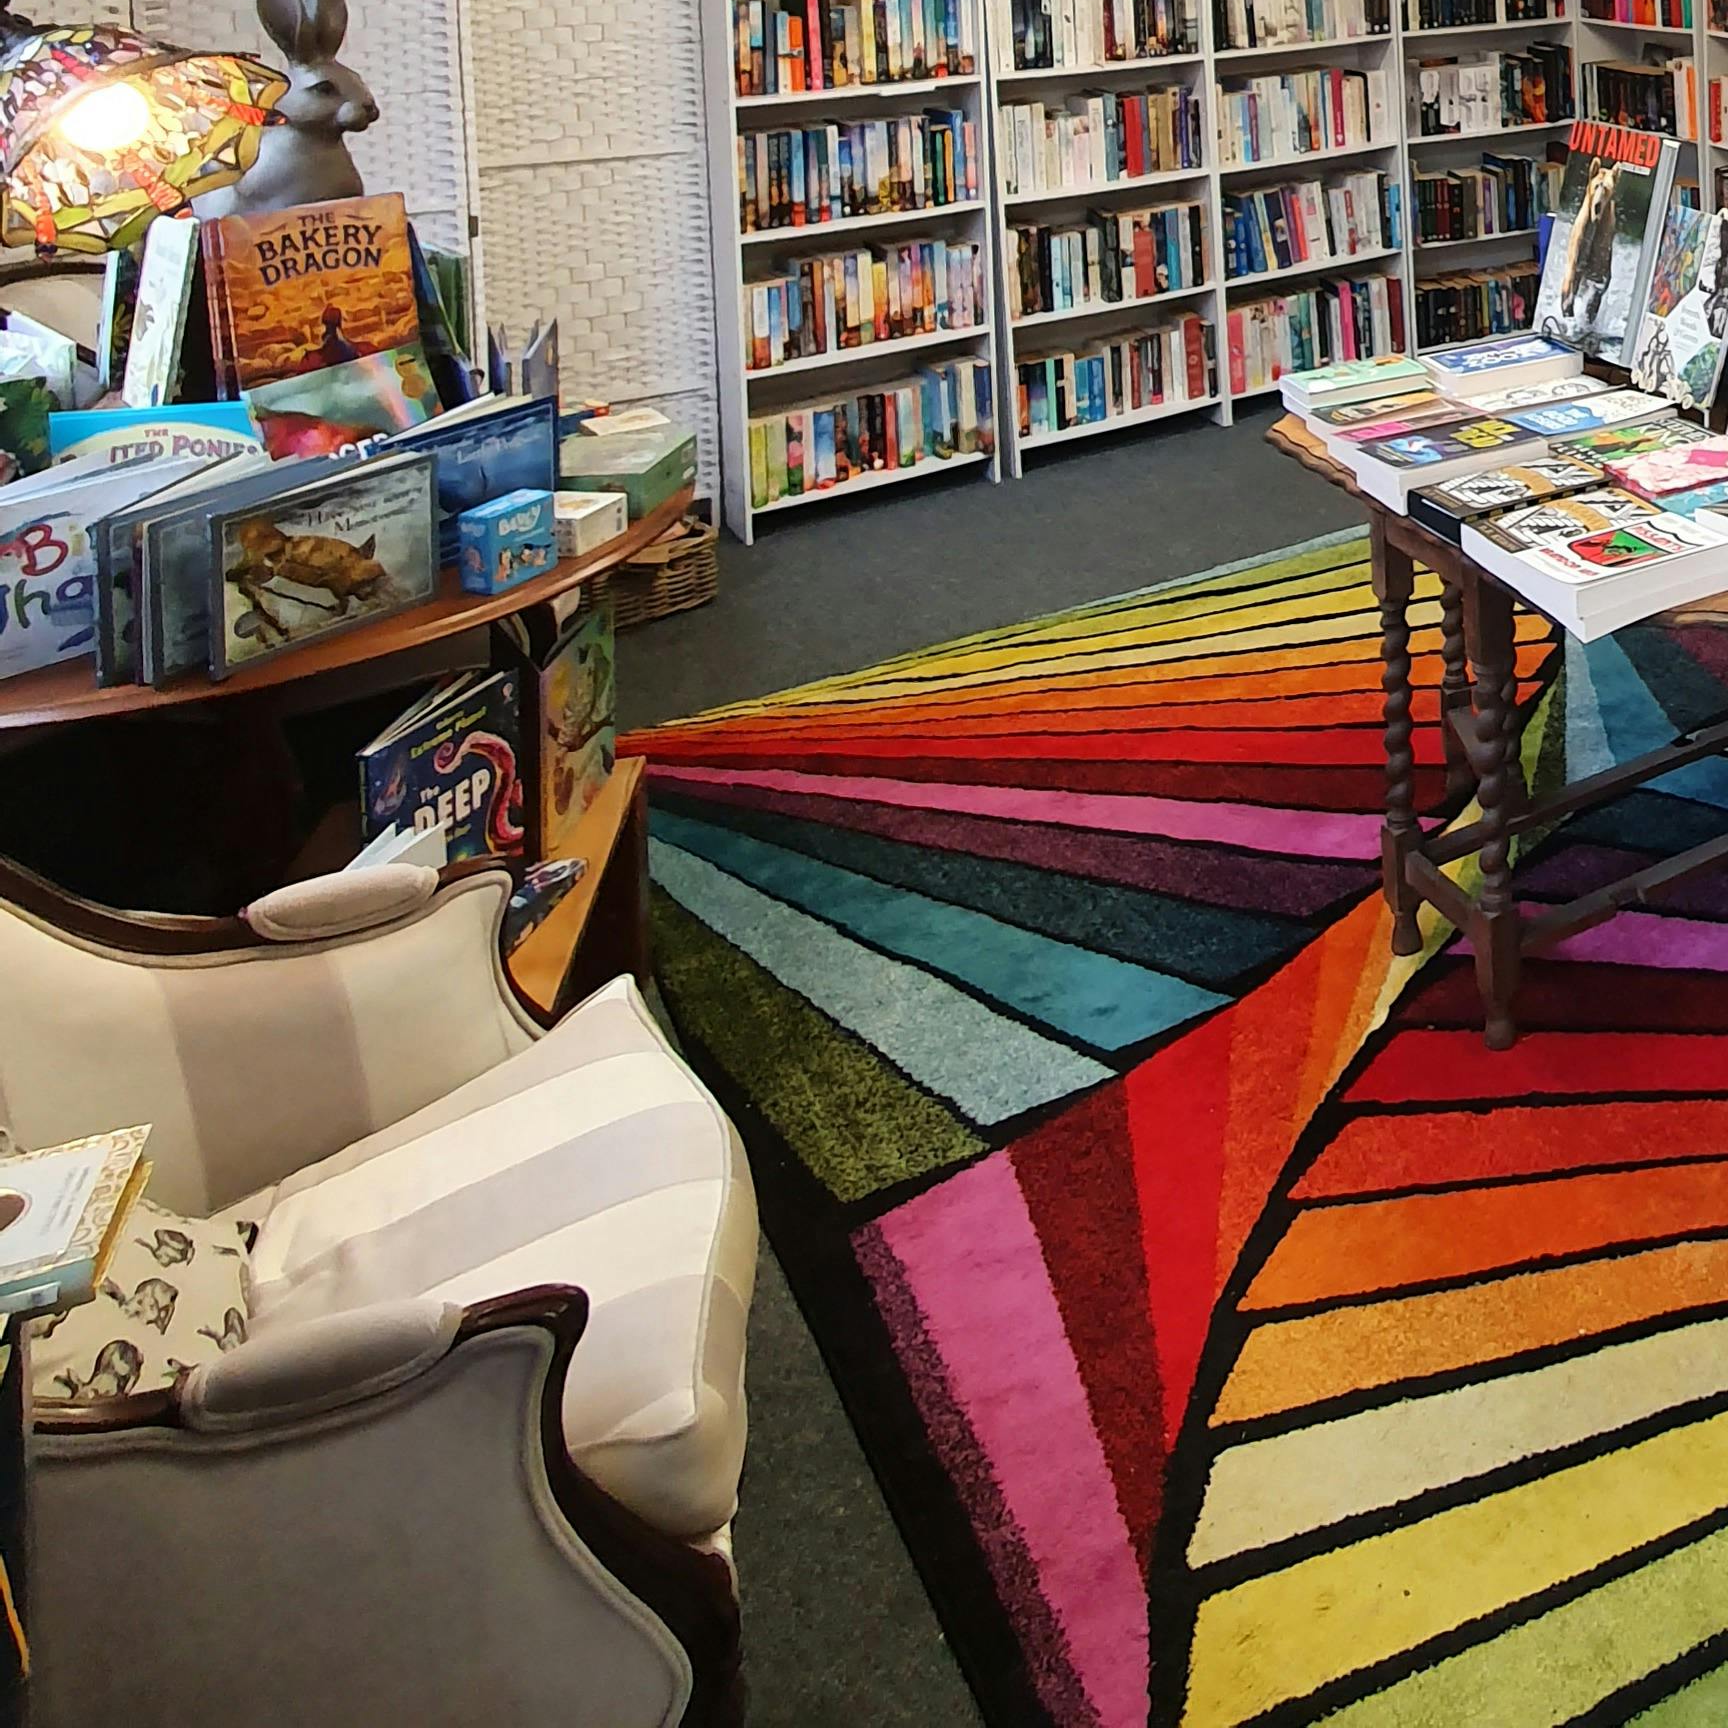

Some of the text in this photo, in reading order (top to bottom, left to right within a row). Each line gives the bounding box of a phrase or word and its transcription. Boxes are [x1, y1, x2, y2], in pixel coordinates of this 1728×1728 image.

[1569, 121, 1661, 168] UNTAMED
[298, 212, 335, 226] THE
[254, 224, 382, 263] BAKERY
[259, 247, 382, 287] DRAGON
[144, 429, 168, 438] THE
[414, 768, 491, 836] DEEP
